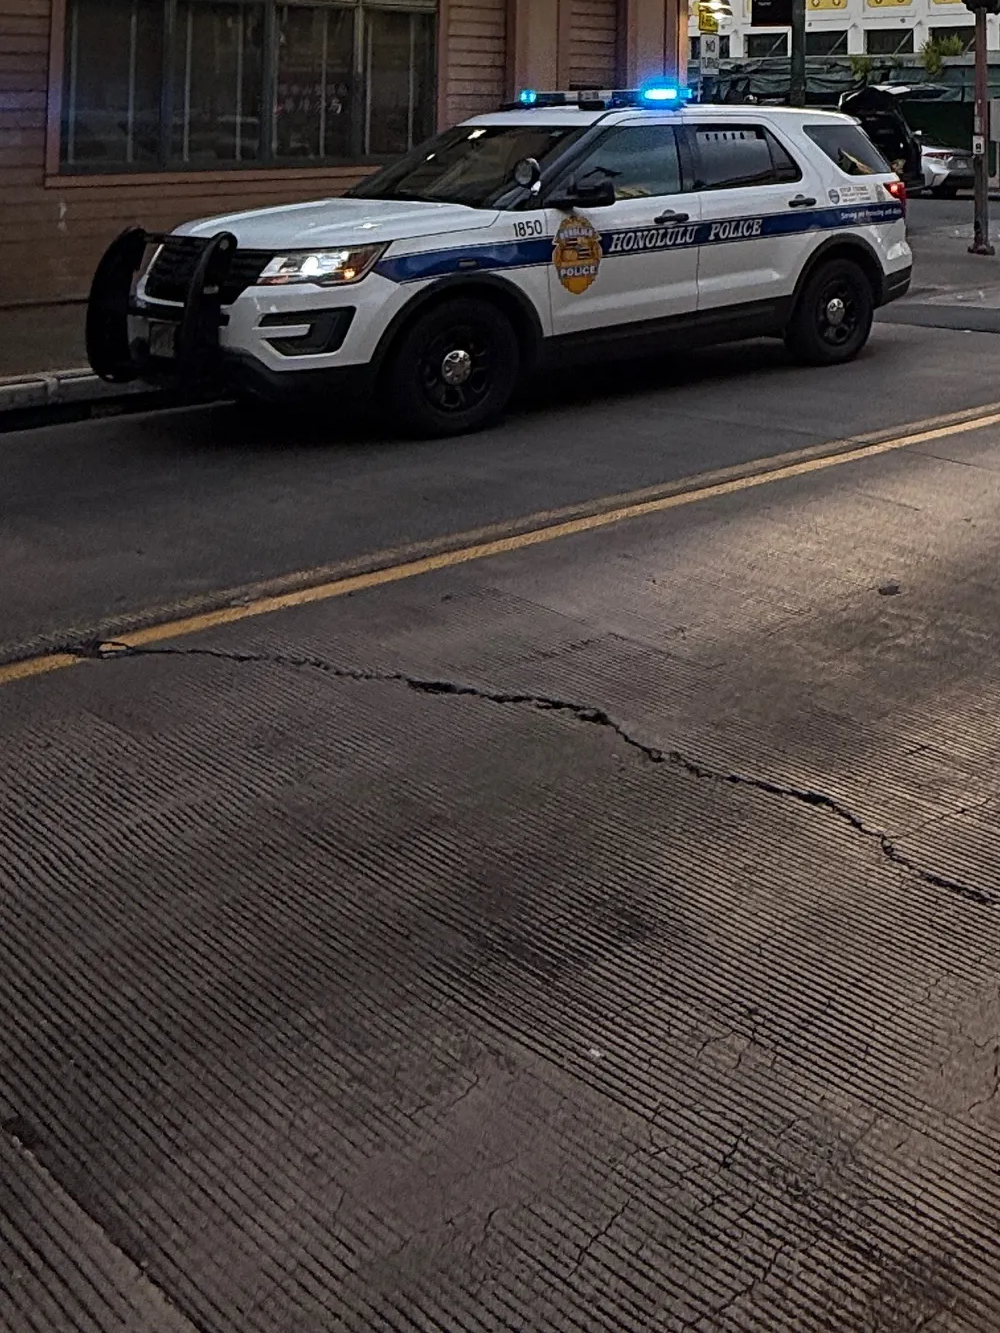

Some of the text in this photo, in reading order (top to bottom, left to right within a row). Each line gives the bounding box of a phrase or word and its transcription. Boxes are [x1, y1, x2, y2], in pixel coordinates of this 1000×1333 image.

[513, 219, 543, 238] 1850
[608, 219, 764, 252] HONOLULU POLICE
[560, 265, 597, 277] POLICE
